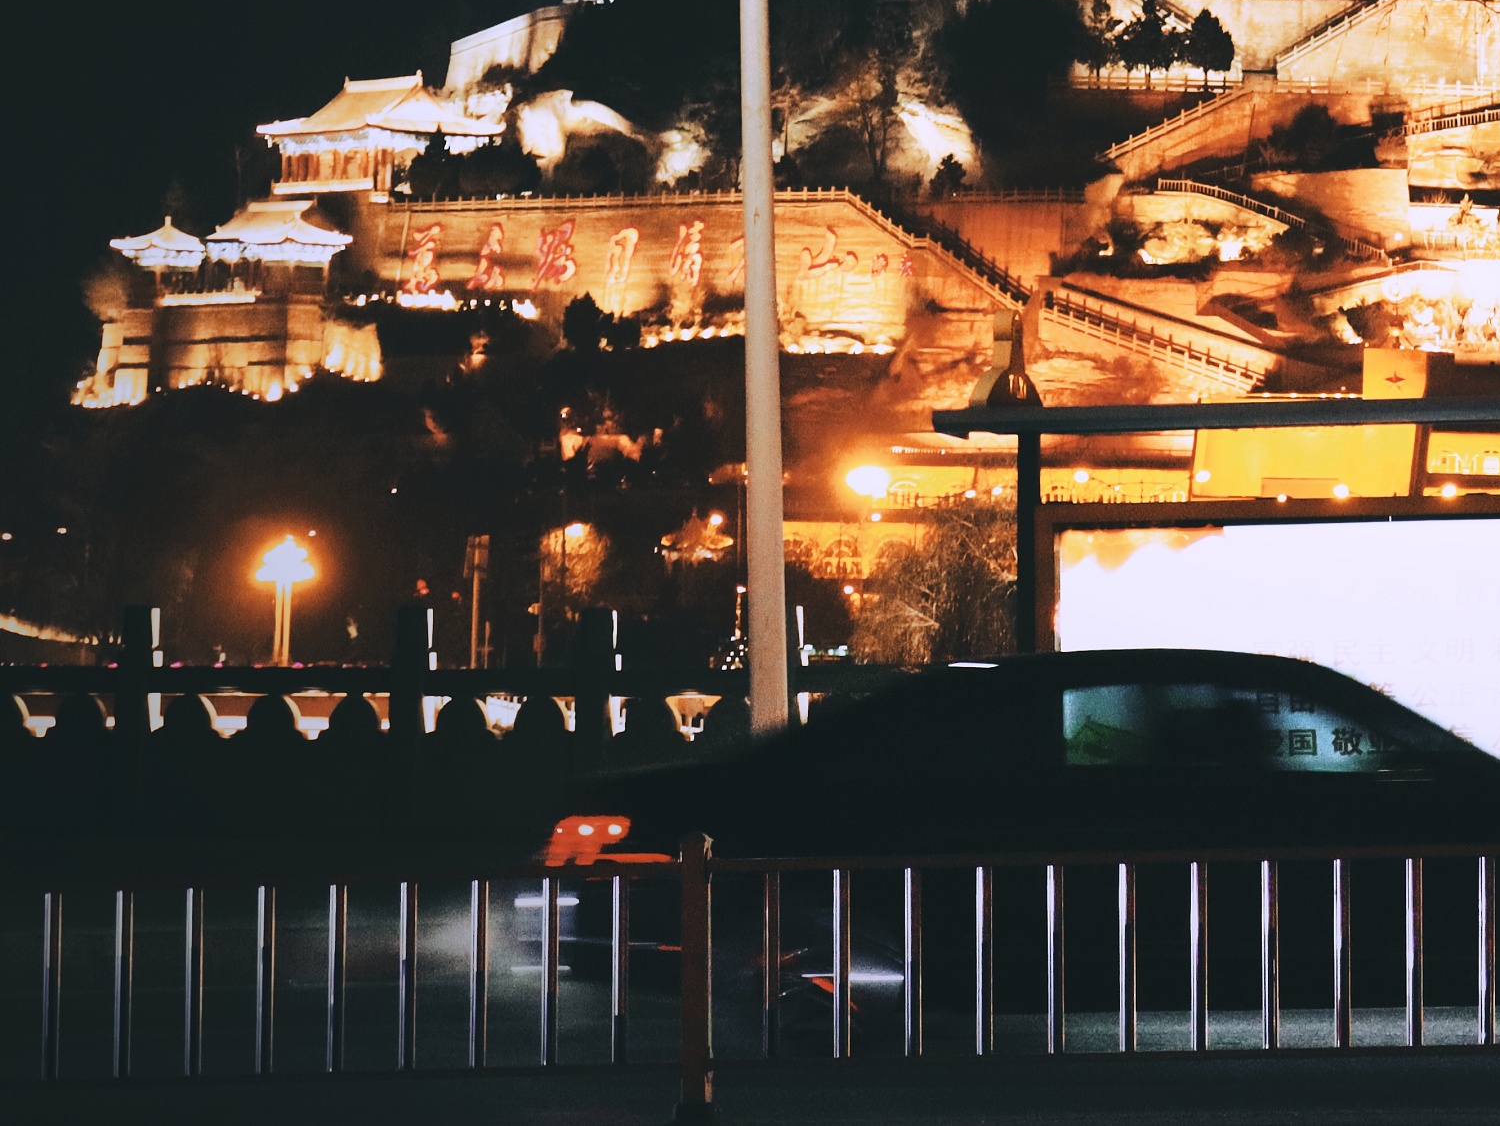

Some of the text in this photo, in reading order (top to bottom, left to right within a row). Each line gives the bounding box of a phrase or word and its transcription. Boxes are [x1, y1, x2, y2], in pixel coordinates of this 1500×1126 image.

[1333, 639, 1395, 667] 民主
[1412, 638, 1475, 665] 文明
[1411, 680, 1476, 708] 公正
